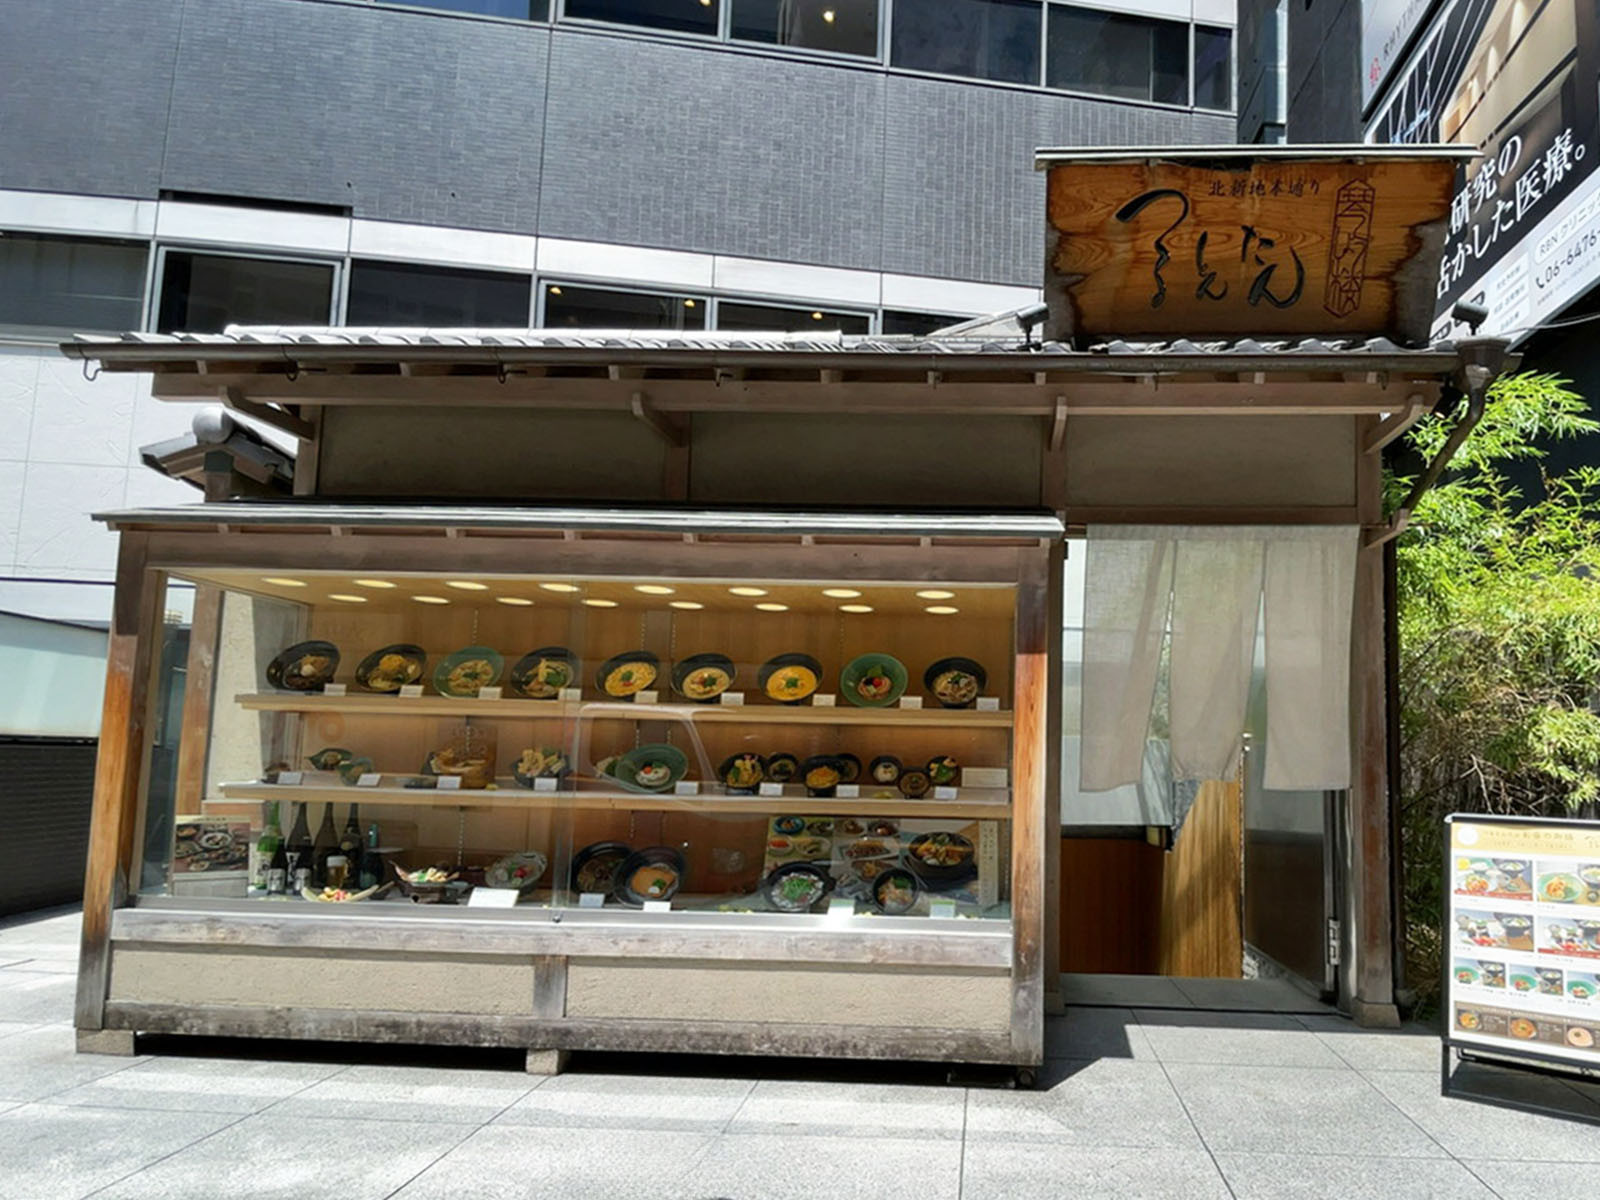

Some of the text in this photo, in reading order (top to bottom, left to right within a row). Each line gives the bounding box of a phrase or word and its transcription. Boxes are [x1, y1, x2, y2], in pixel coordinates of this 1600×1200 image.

[1207, 177, 1320, 199] 北新地本通り
[1445, 134, 1522, 246] 研究の
